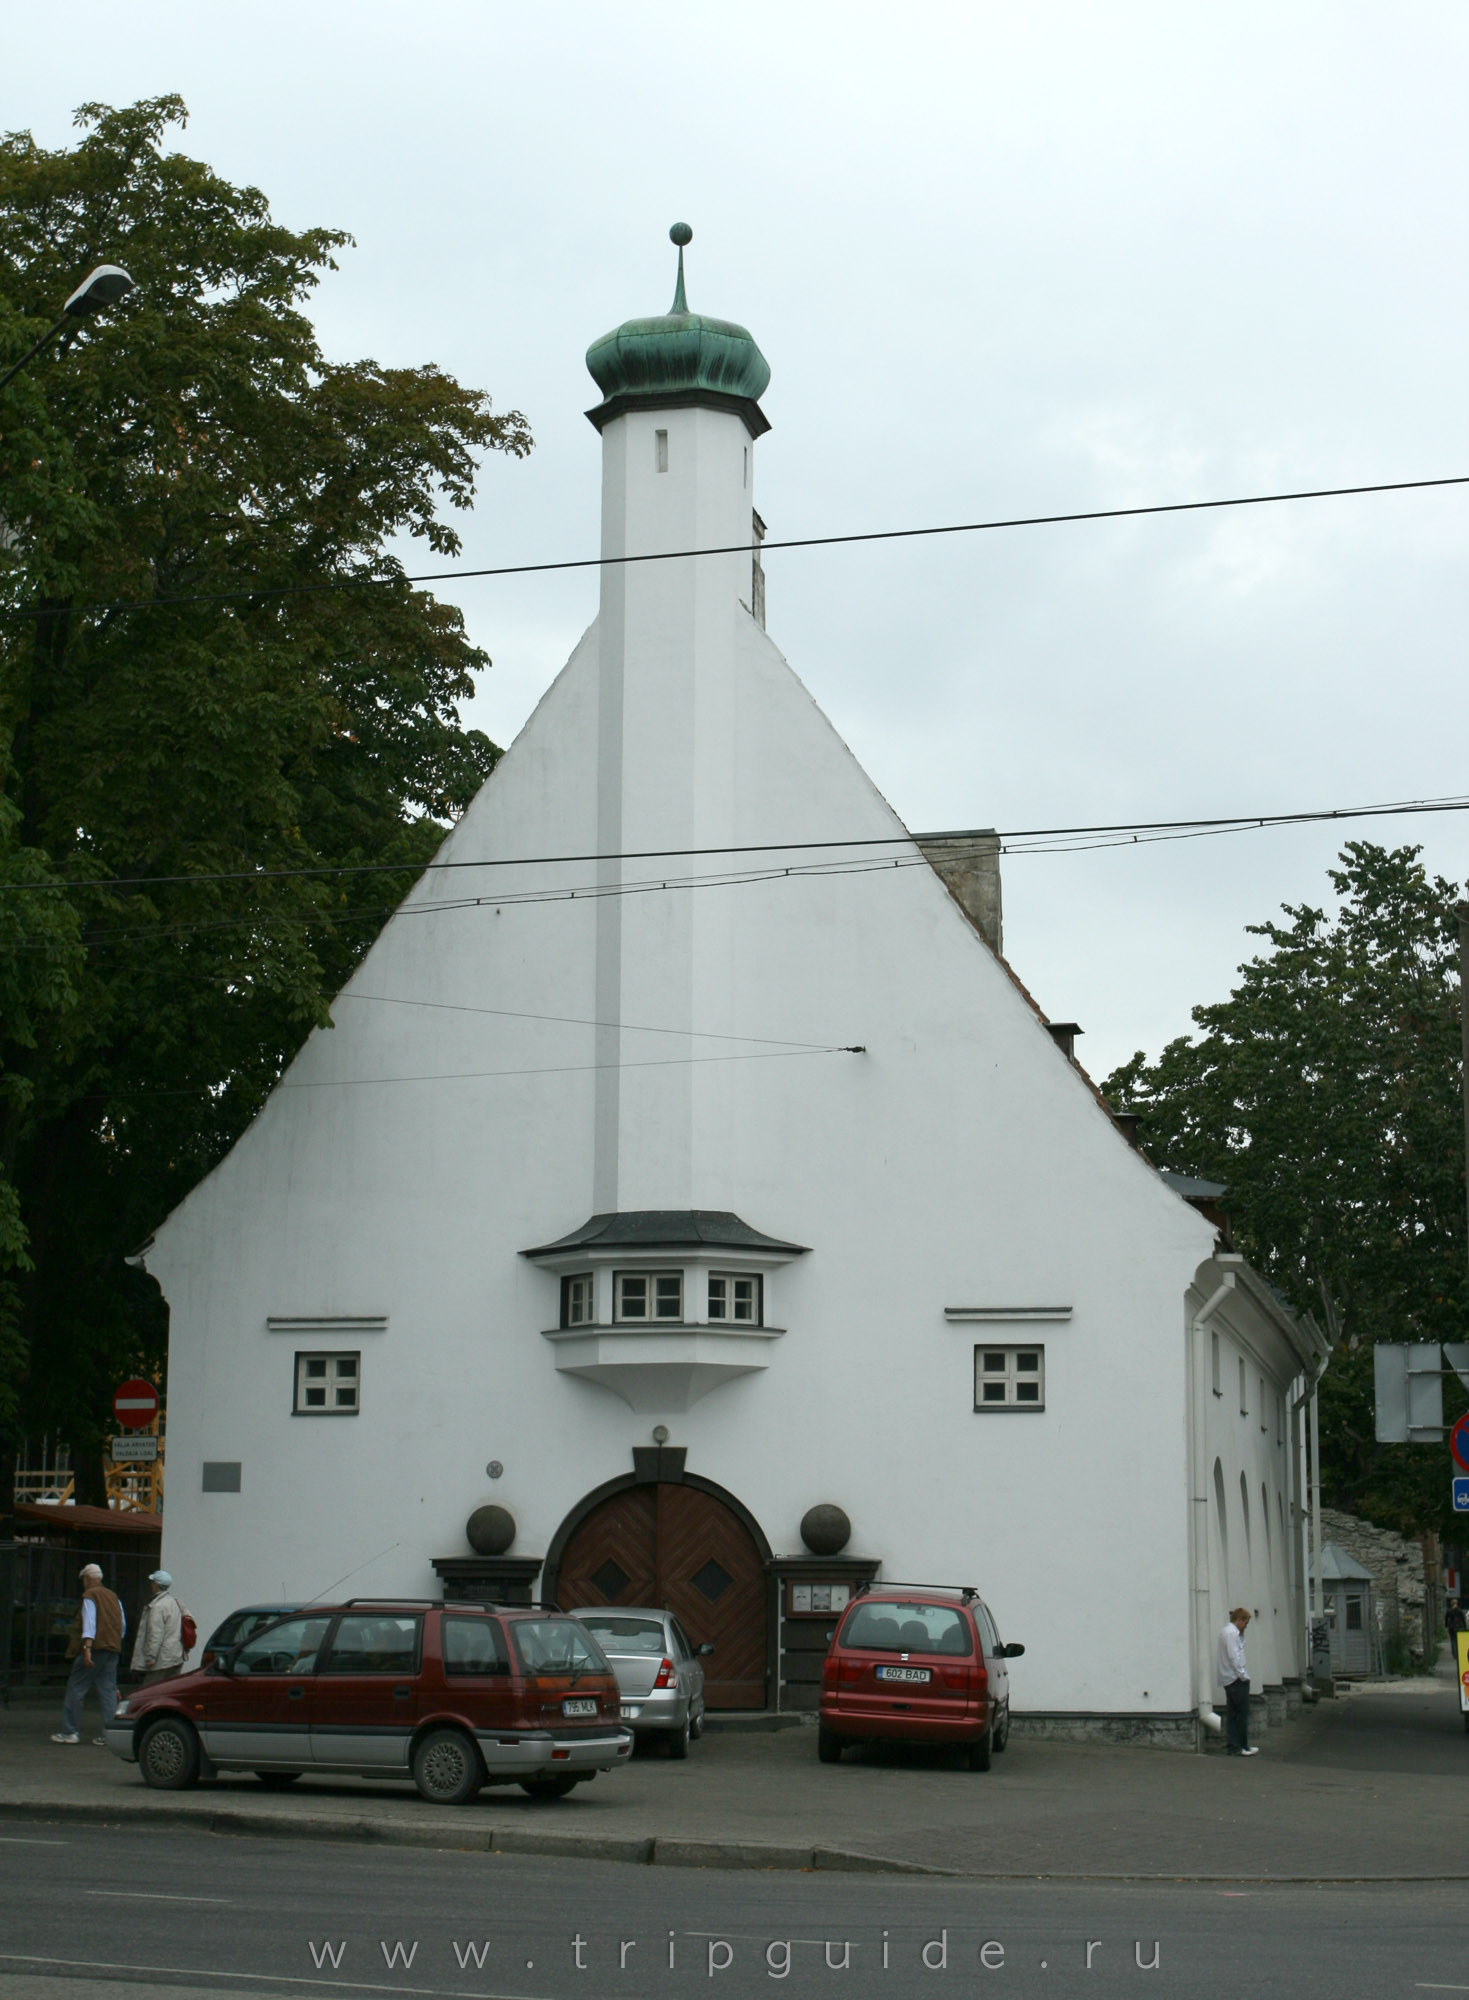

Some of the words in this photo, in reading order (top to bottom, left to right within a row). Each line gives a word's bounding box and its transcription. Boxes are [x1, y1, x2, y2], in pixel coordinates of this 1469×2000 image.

[886, 1668, 903, 1678] 602
[906, 1669, 927, 1680] BAD
[568, 1701, 579, 1713] 795
[581, 1700, 596, 1712] MLK
